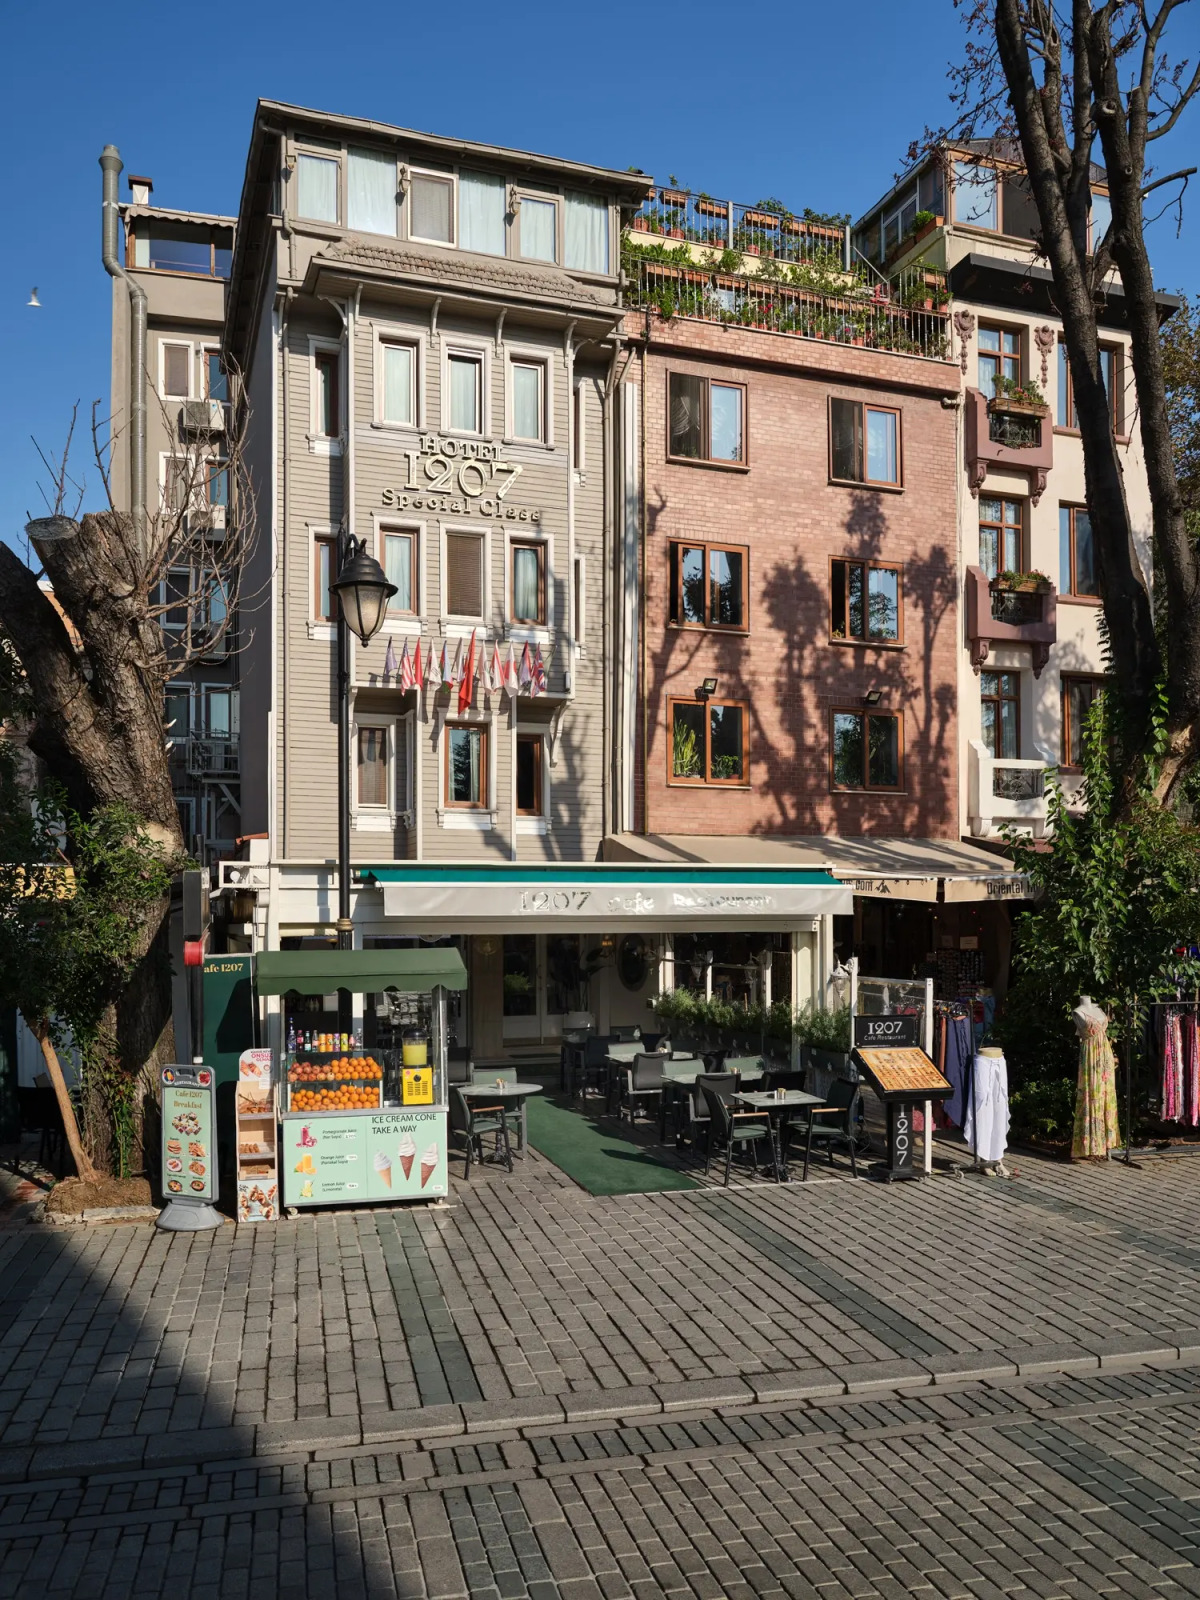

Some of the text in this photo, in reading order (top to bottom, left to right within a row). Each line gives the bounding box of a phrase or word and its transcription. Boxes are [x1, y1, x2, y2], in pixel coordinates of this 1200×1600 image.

[382, 488, 541, 522] Special Class
[986, 881, 1023, 895] Oriental
[519, 891, 592, 912] 1207
[204, 963, 243, 973] afe 1207
[868, 1021, 903, 1034] 1207
[173, 1101, 202, 1109] Breakfast
[372, 1113, 437, 1124] ICE CREAM CONE
[372, 1126, 391, 1134] TAKE
